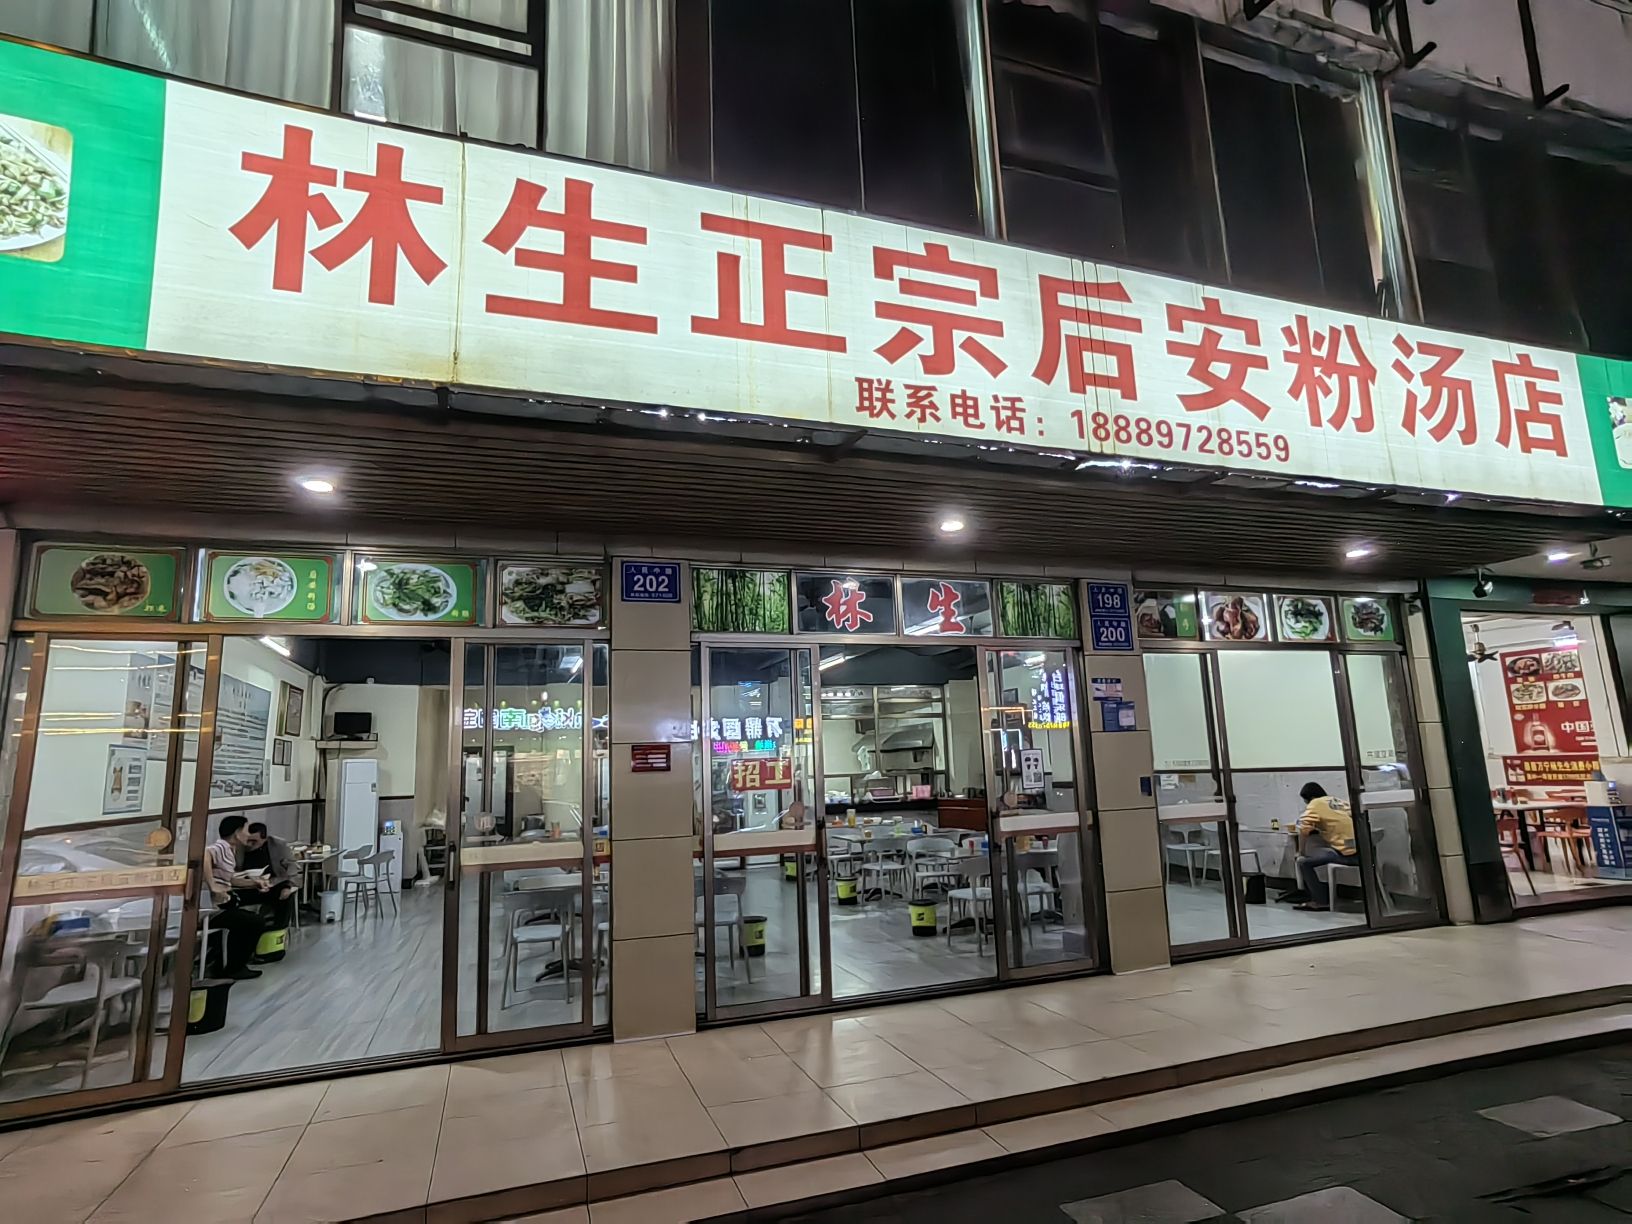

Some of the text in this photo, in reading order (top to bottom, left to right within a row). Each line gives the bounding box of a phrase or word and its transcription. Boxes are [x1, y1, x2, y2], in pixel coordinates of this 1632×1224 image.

[228, 124, 1568, 458] 林生正宗后安粉汤店
[1070, 408, 1291, 463] 18889728559
[633, 574, 669, 592] 202
[822, 577, 966, 634] 林 生
[1097, 593, 1121, 609] 198
[1100, 627, 1125, 642] 200
[733, 760, 791, 788] 招工
